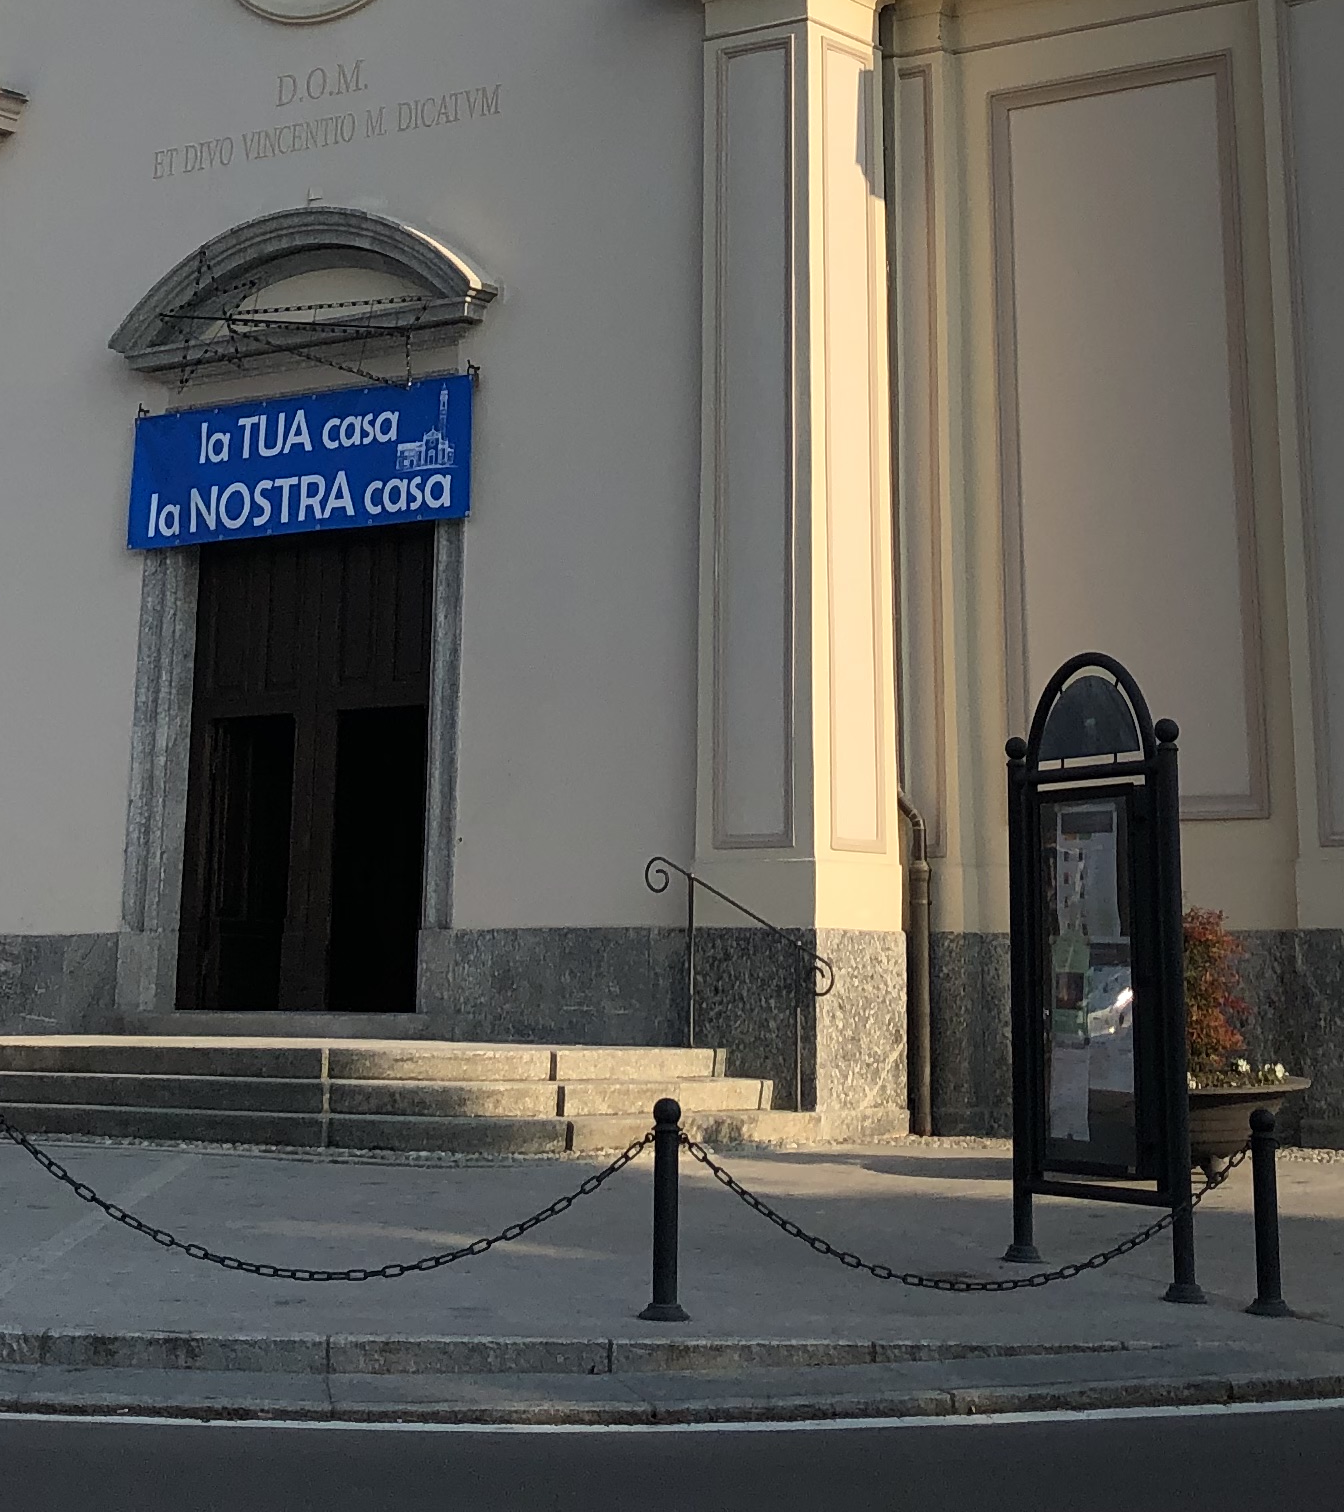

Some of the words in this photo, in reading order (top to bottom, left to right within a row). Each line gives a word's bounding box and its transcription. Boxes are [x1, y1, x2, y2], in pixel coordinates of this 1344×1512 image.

[276, 59, 368, 107] D.O.M.
[153, 149, 179, 180] ET
[183, 137, 233, 174] DIVO
[242, 112, 356, 161] VINCENTIO
[365, 106, 387, 138] M.
[396, 83, 502, 132] DICATVM
[199, 421, 231, 464] la
[238, 409, 313, 459] TUA
[322, 410, 399, 449] casa
[147, 493, 181, 538] la
[189, 470, 355, 533] NOSTRA
[364, 474, 452, 515] casa
